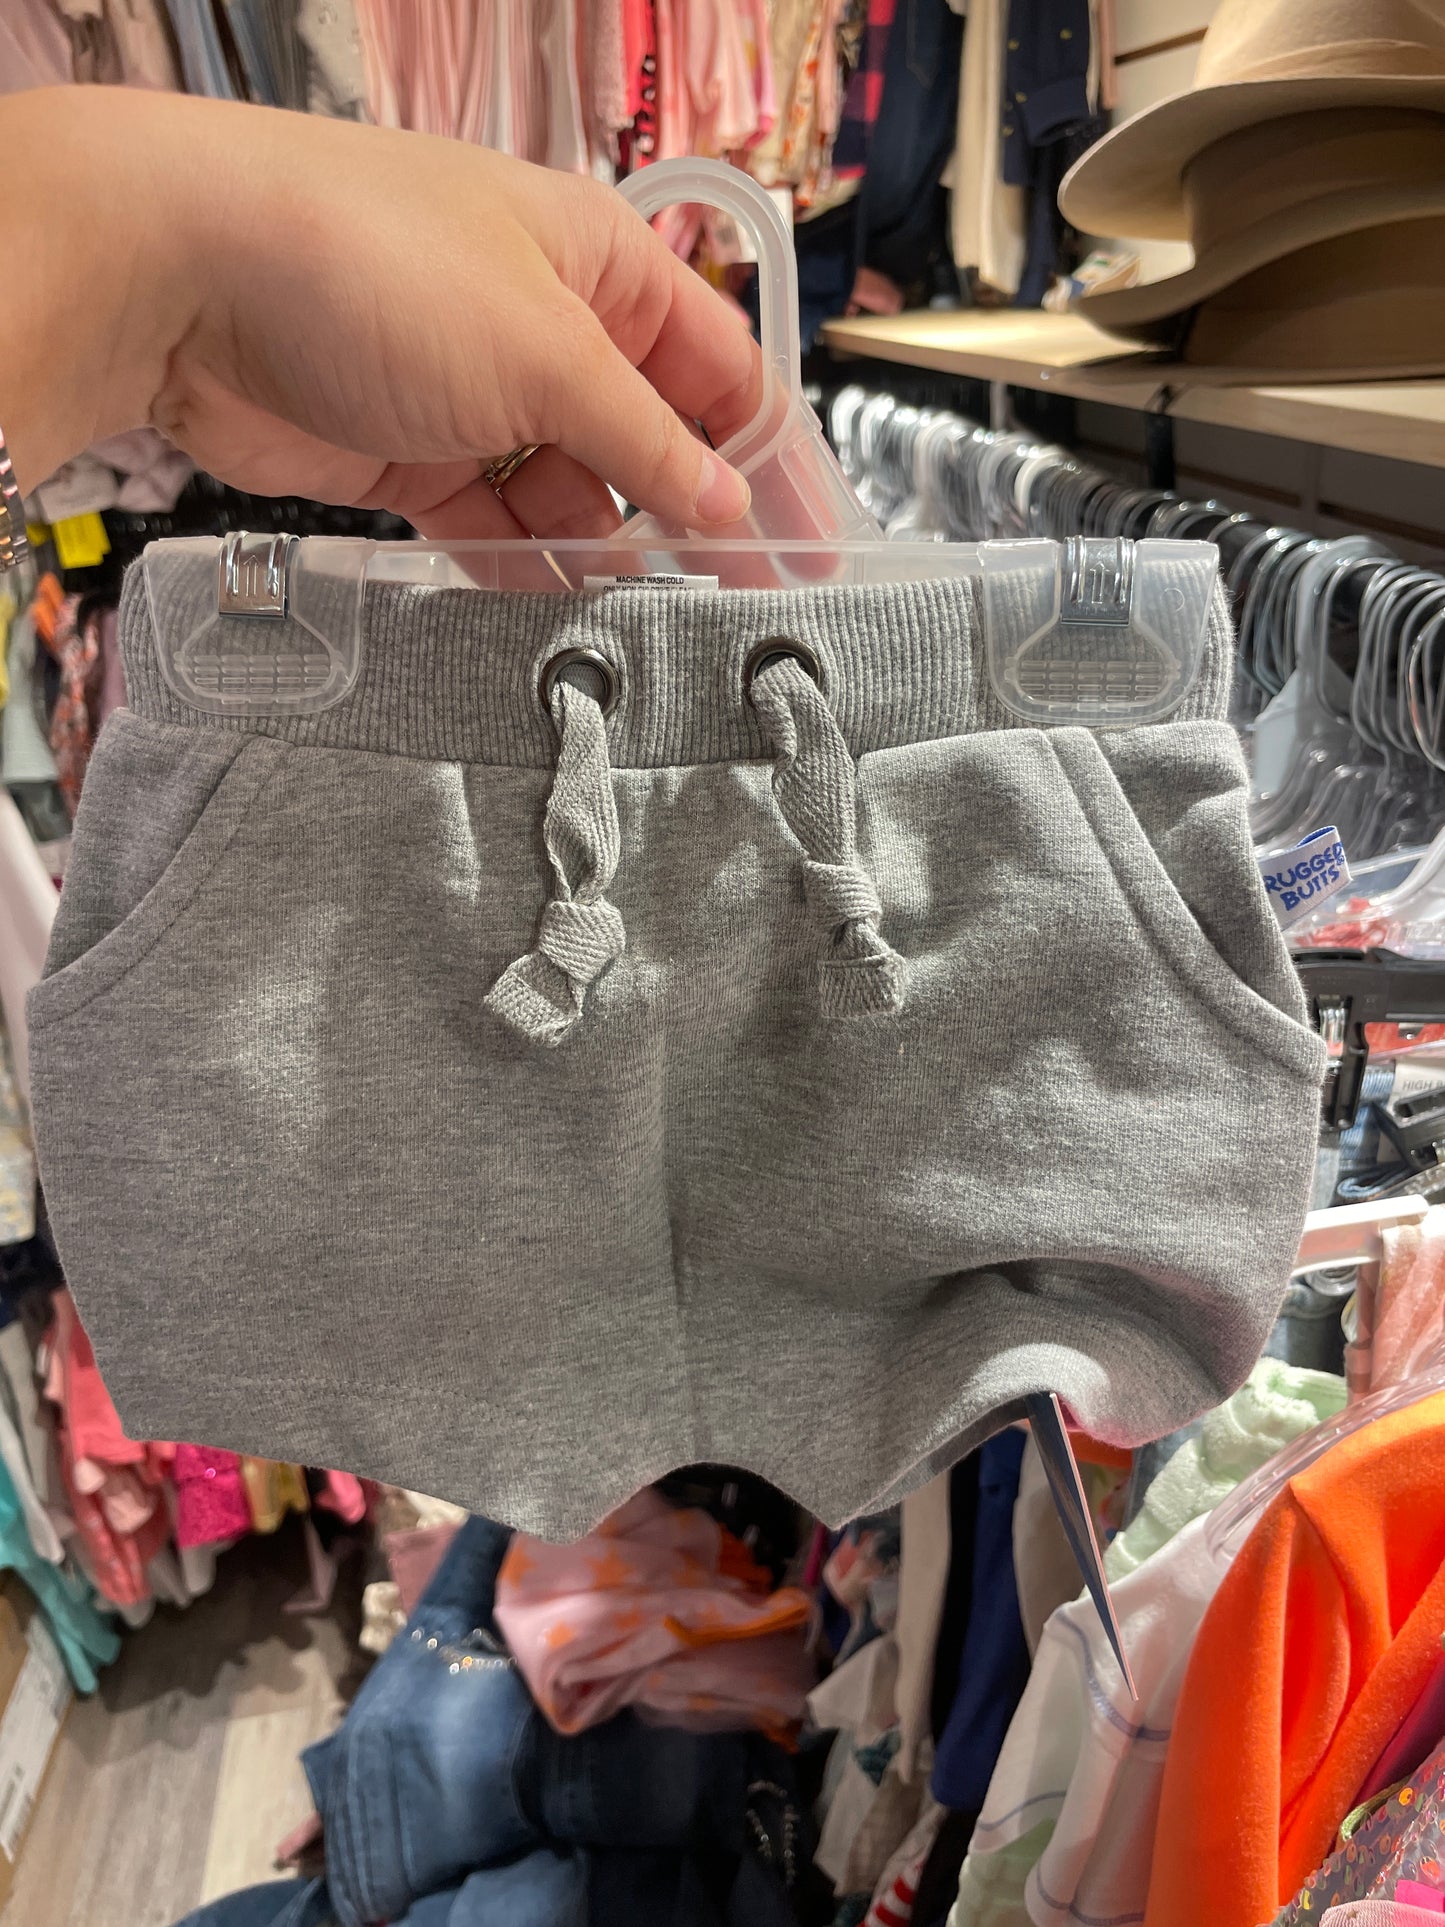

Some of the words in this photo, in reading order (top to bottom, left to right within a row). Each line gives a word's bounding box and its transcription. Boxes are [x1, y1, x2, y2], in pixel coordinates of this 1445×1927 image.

[615, 576, 646, 584] MACHINE
[647, 576, 665, 584] WASH
[666, 577, 685, 585] COLD
[1280, 865, 1340, 911] BUTTS
